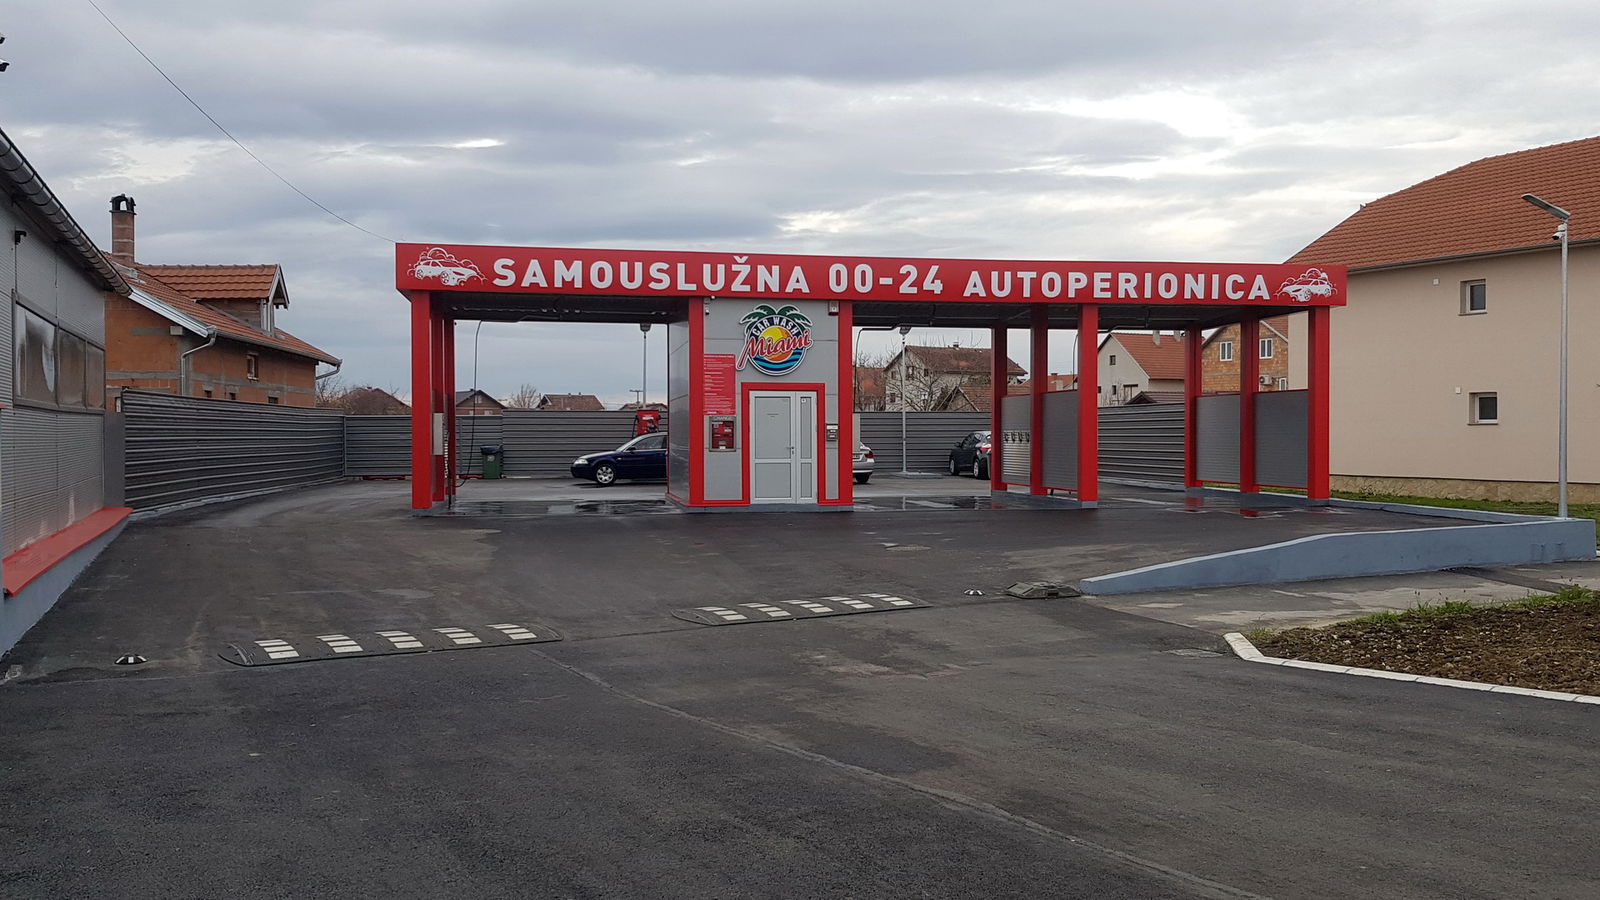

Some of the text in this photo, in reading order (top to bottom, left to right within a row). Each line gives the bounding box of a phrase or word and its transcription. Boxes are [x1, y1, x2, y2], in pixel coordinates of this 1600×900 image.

[491, 255, 1271, 300] SAMOUSLUŽNA 00-24 AUTOPERIONICA
[752, 316, 799, 336] CAR WASH
[739, 330, 811, 367] Miami
